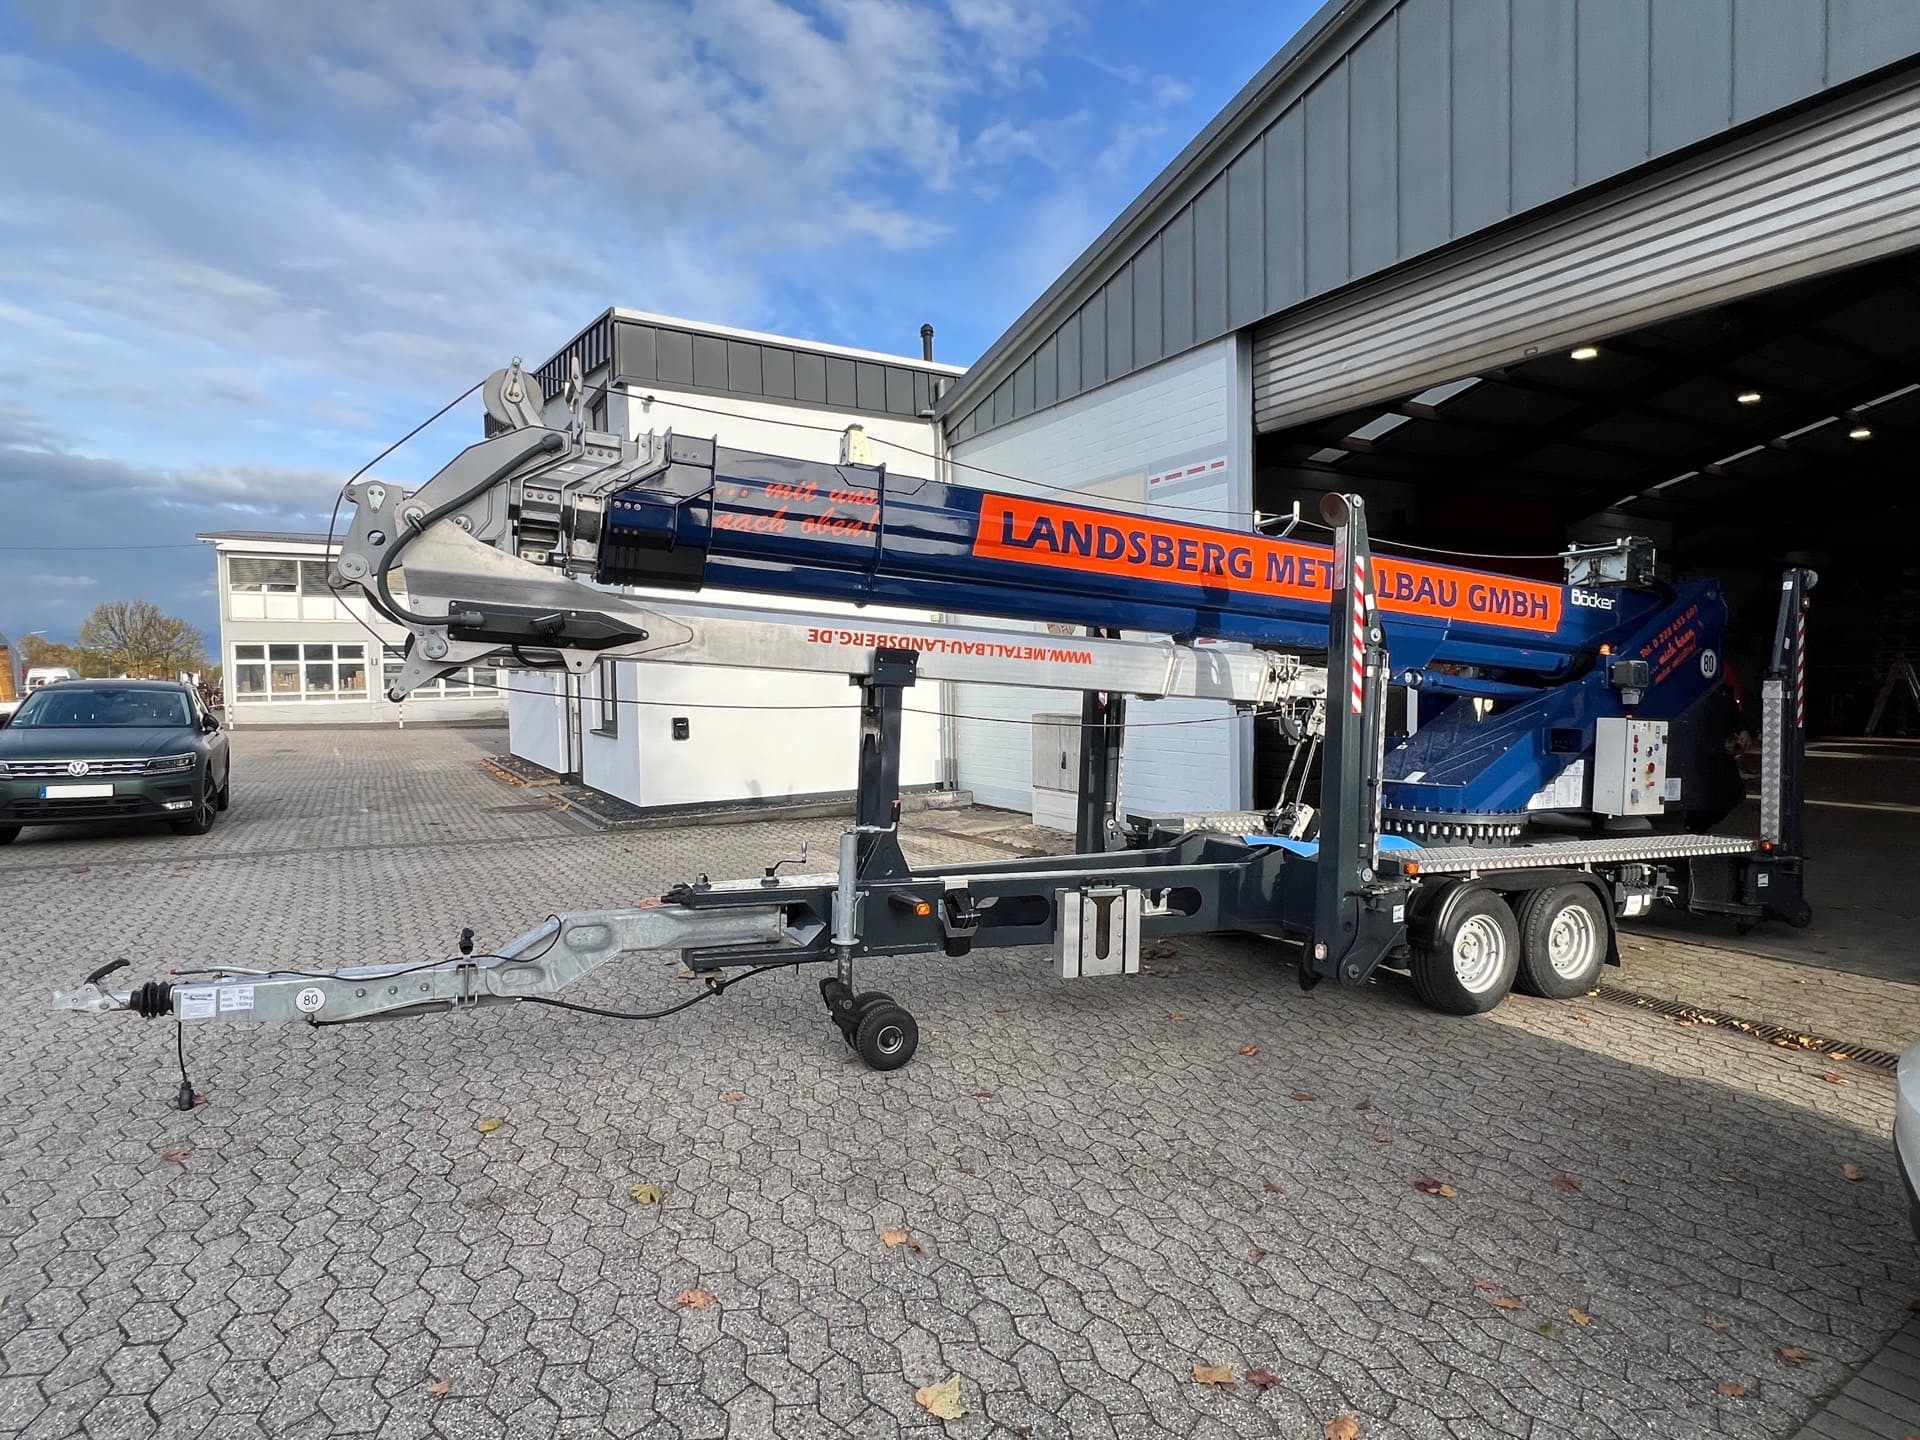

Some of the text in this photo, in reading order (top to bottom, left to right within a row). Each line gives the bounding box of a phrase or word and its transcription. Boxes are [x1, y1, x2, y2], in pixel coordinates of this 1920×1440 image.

[765, 481, 819, 502] mit
[829, 487, 879, 506] uns
[713, 505, 880, 538] nach oben!
[1002, 511, 1548, 620] LANDSBERG METLBAU GMBH
[1571, 588, 1616, 610] Böcker
[808, 628, 1093, 664] WWW.METALLBAU-LANDSBERG.DE
[1703, 654, 1714, 673] 80
[303, 994, 318, 1006] 80
